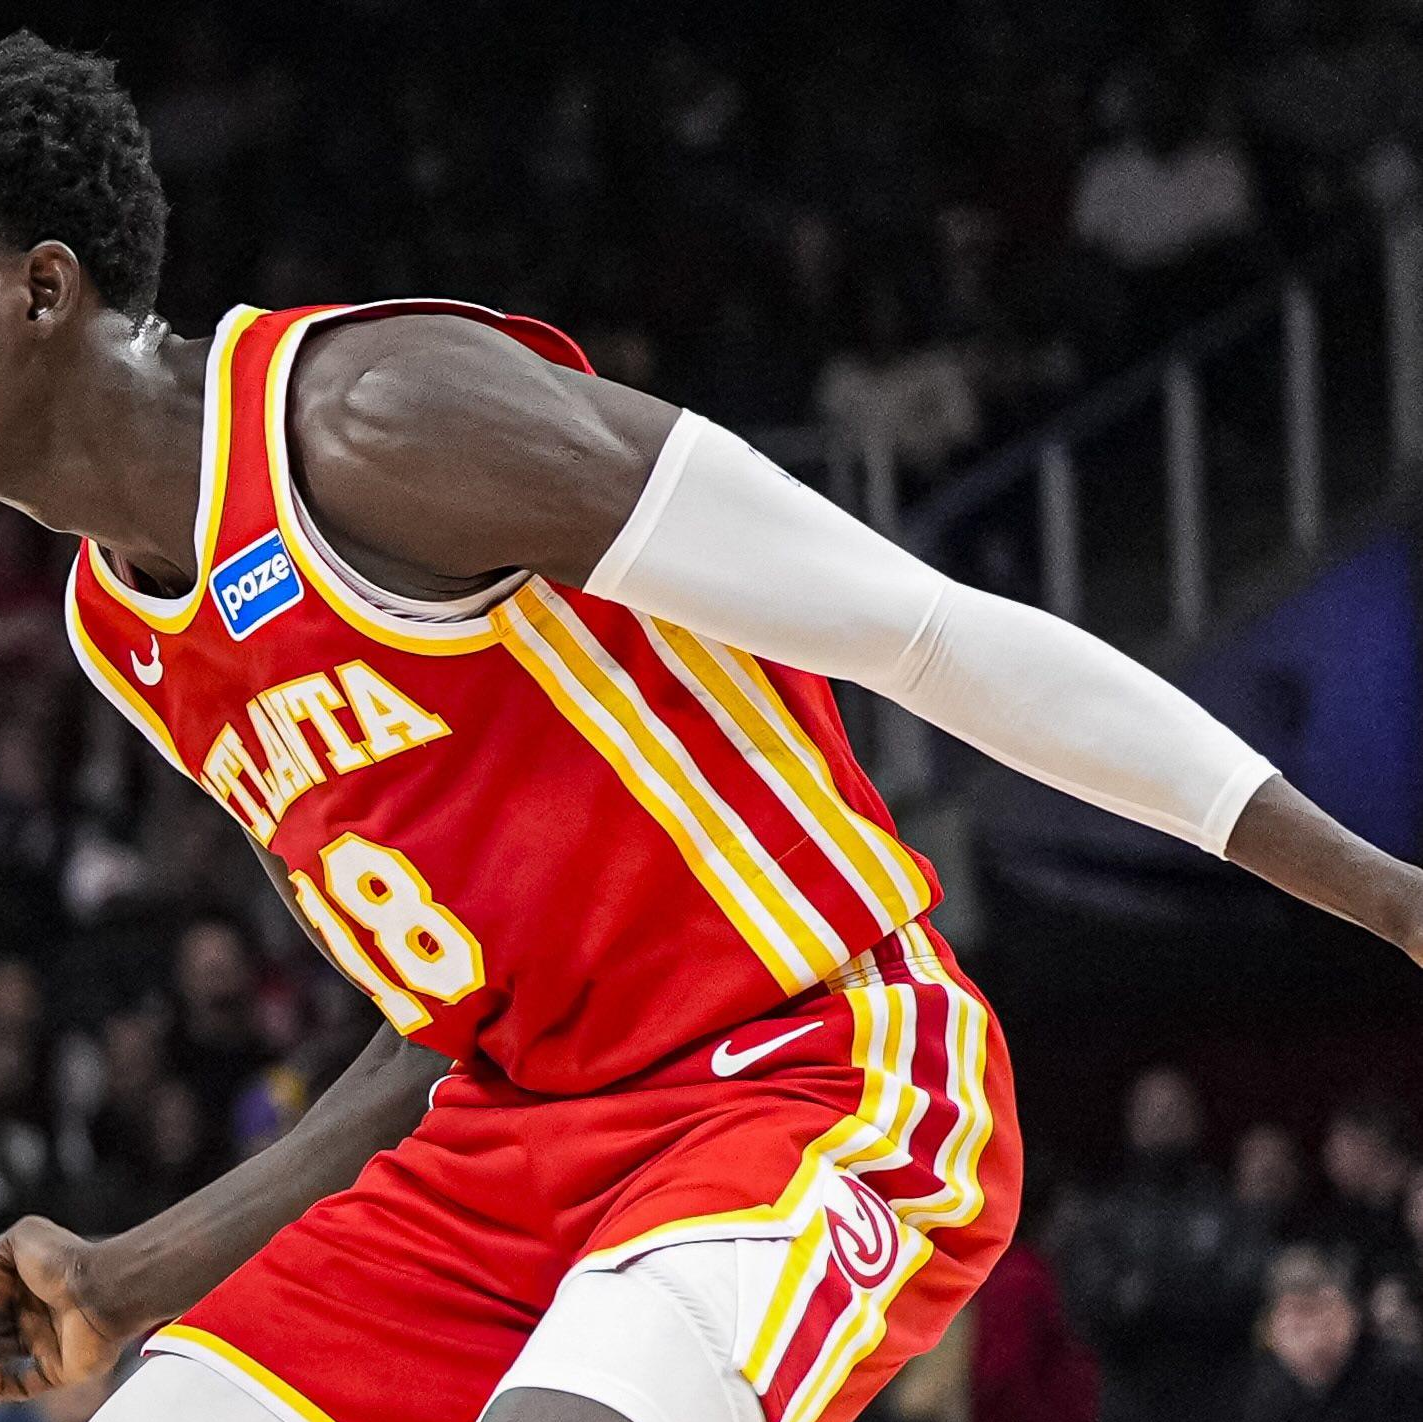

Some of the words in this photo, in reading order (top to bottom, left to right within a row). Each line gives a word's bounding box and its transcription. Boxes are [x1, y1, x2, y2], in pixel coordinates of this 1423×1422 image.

[221, 553, 291, 621] paze
[200, 659, 453, 849] TLANTA
[288, 830, 487, 1037] 18
